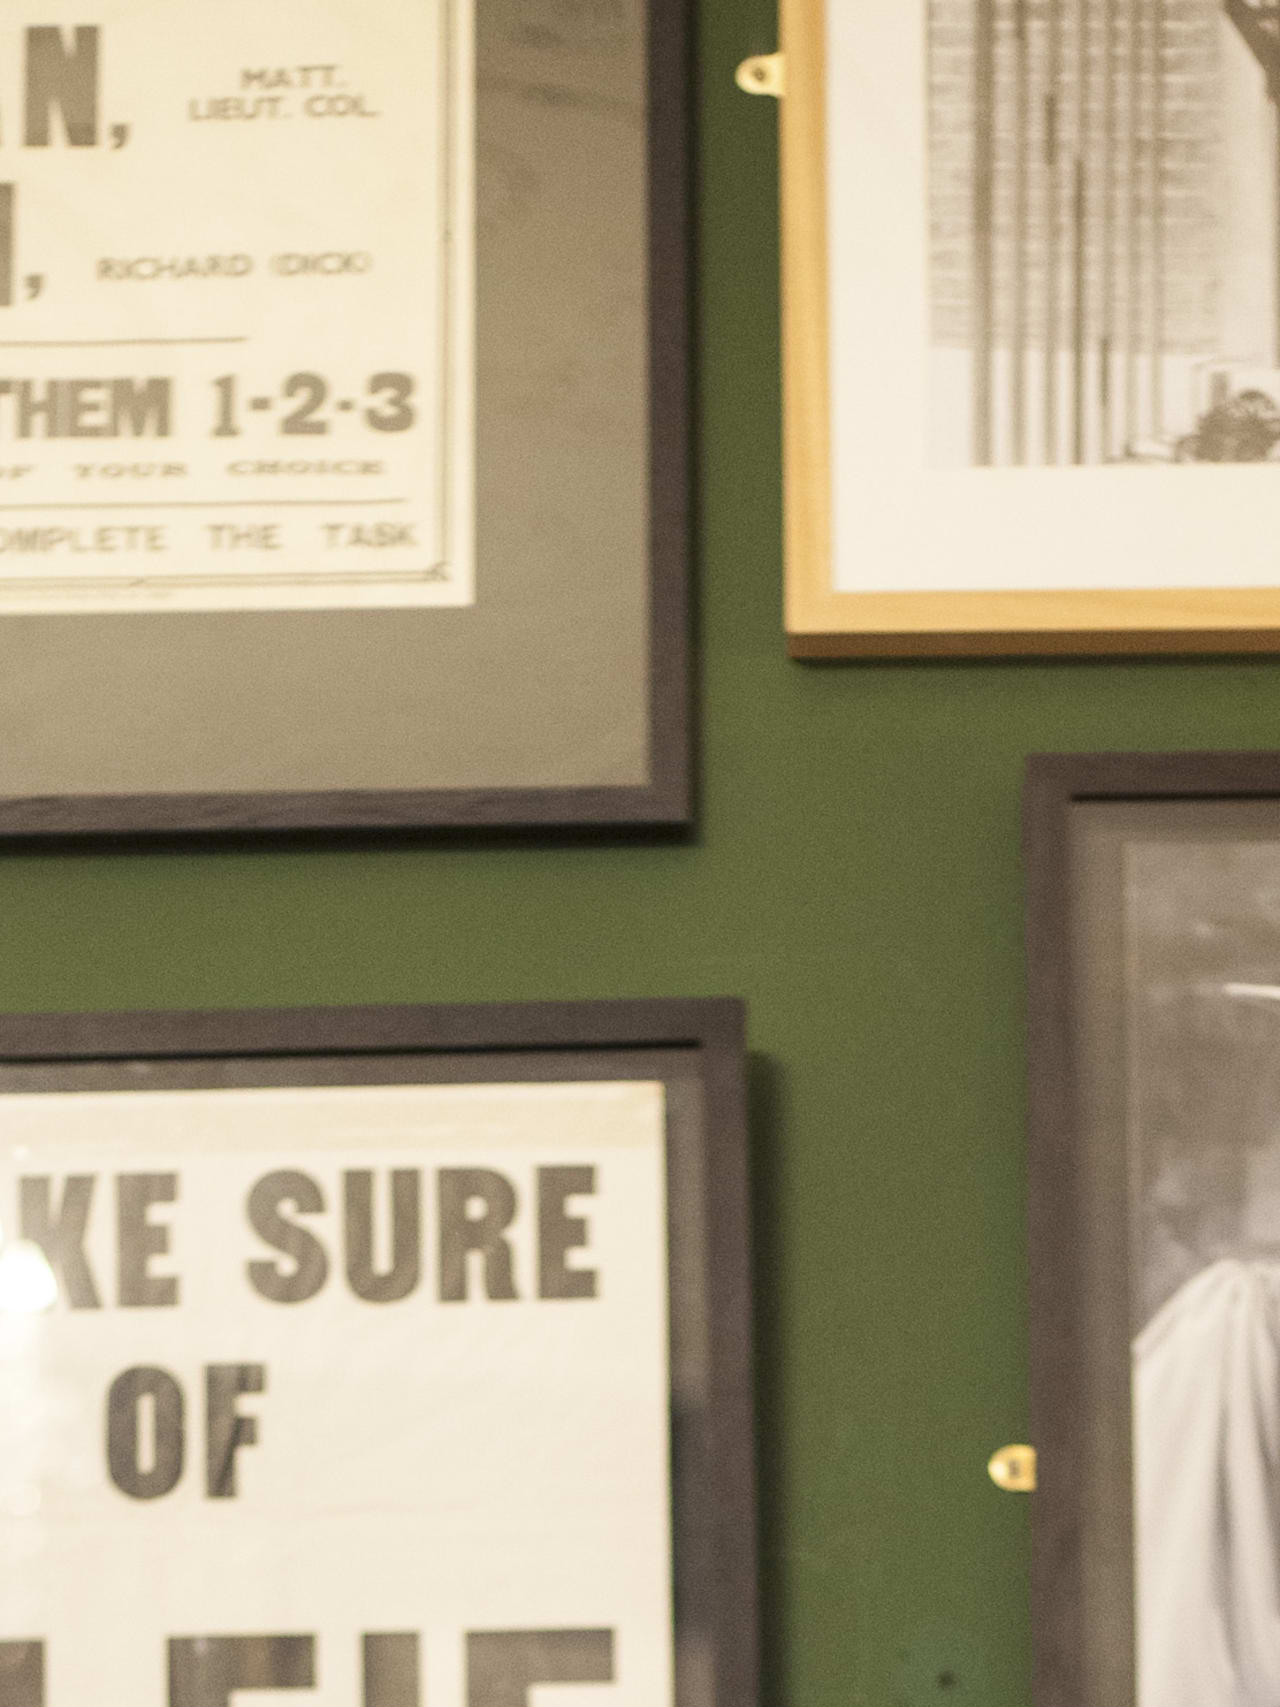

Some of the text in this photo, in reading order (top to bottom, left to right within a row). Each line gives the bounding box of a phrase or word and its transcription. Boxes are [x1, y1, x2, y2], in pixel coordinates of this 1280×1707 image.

[96, 253, 254, 284] RICHARD
[210, 371, 416, 438] 1-2-3
[205, 523, 284, 552] THE
[323, 521, 419, 550] TASK
[243, 1163, 600, 1304] SURE
[104, 1361, 268, 1501] OF
